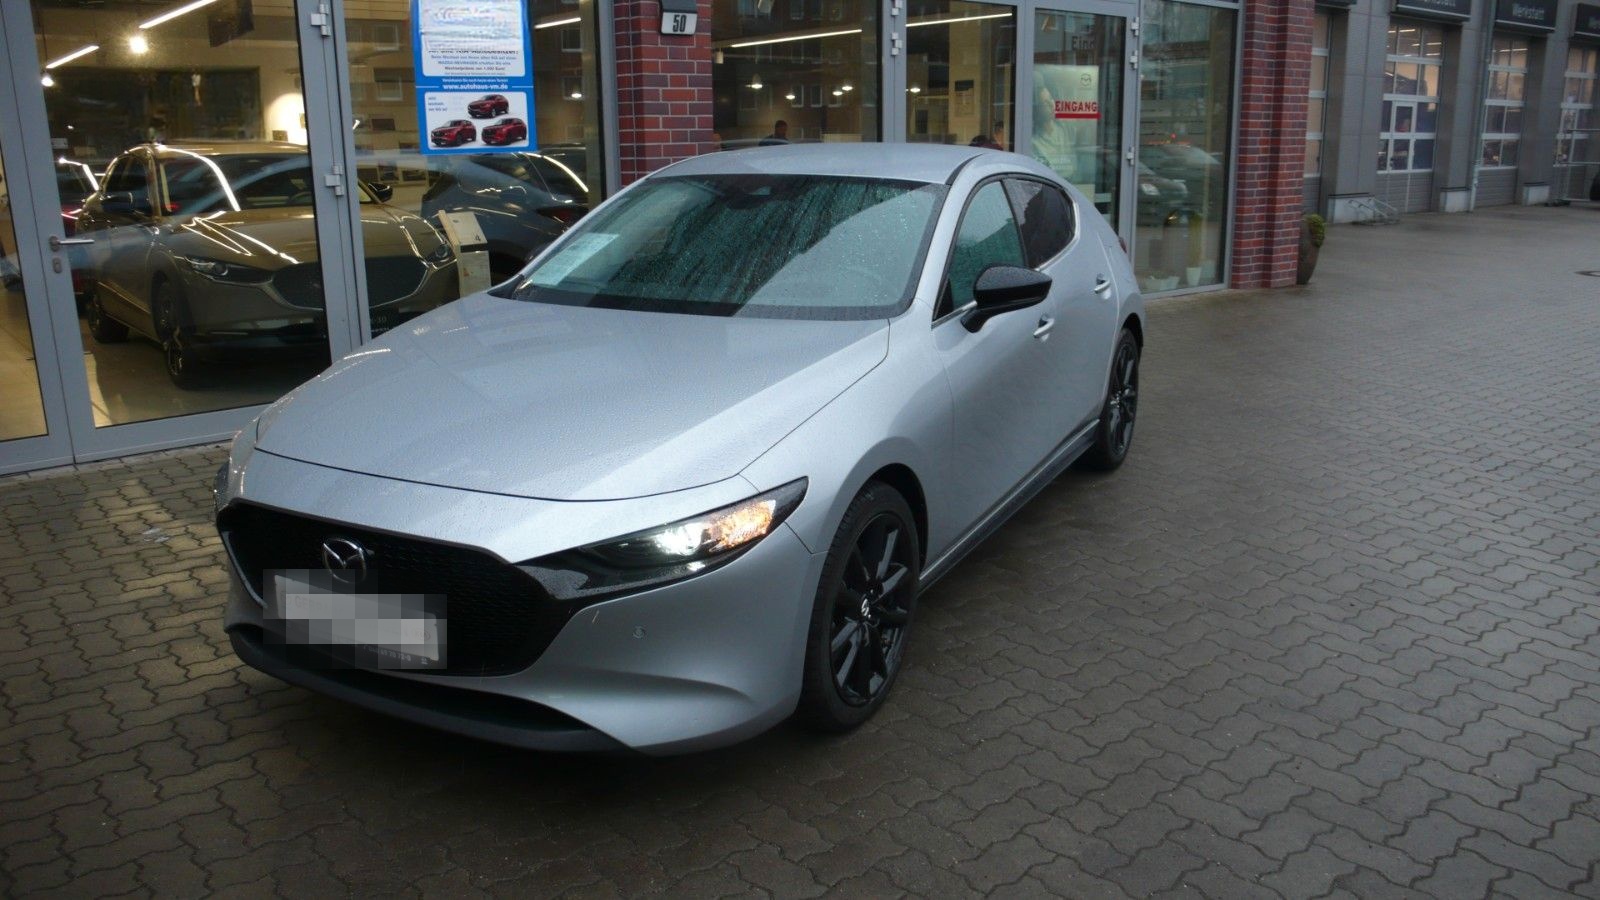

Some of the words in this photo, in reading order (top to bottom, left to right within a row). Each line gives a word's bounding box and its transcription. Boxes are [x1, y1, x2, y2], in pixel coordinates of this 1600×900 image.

[1512, 4, 1545, 20] Werkstatt
[672, 14, 687, 32] 50
[1055, 101, 1098, 111] EINGANG
